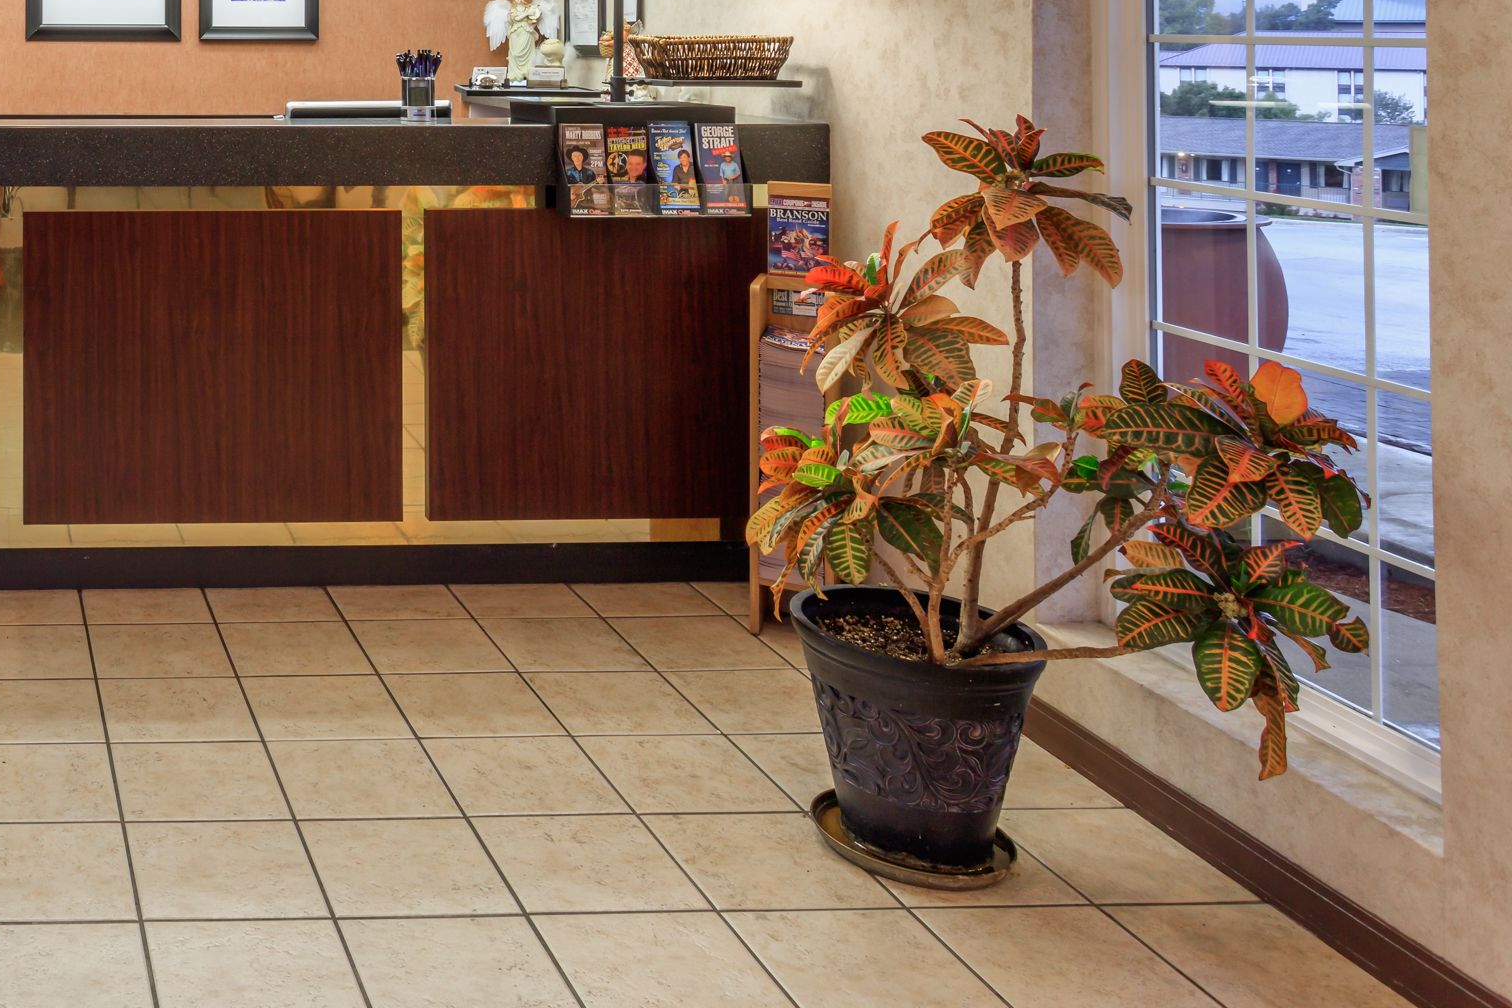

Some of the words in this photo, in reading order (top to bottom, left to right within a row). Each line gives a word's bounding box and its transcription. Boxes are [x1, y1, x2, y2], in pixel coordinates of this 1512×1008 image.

[565, 130, 581, 139] MARTY
[701, 126, 734, 137] GEORGE
[608, 143, 631, 152] TAYLOR
[702, 138, 734, 149] STRAIT
[769, 208, 827, 221] BRANSON
